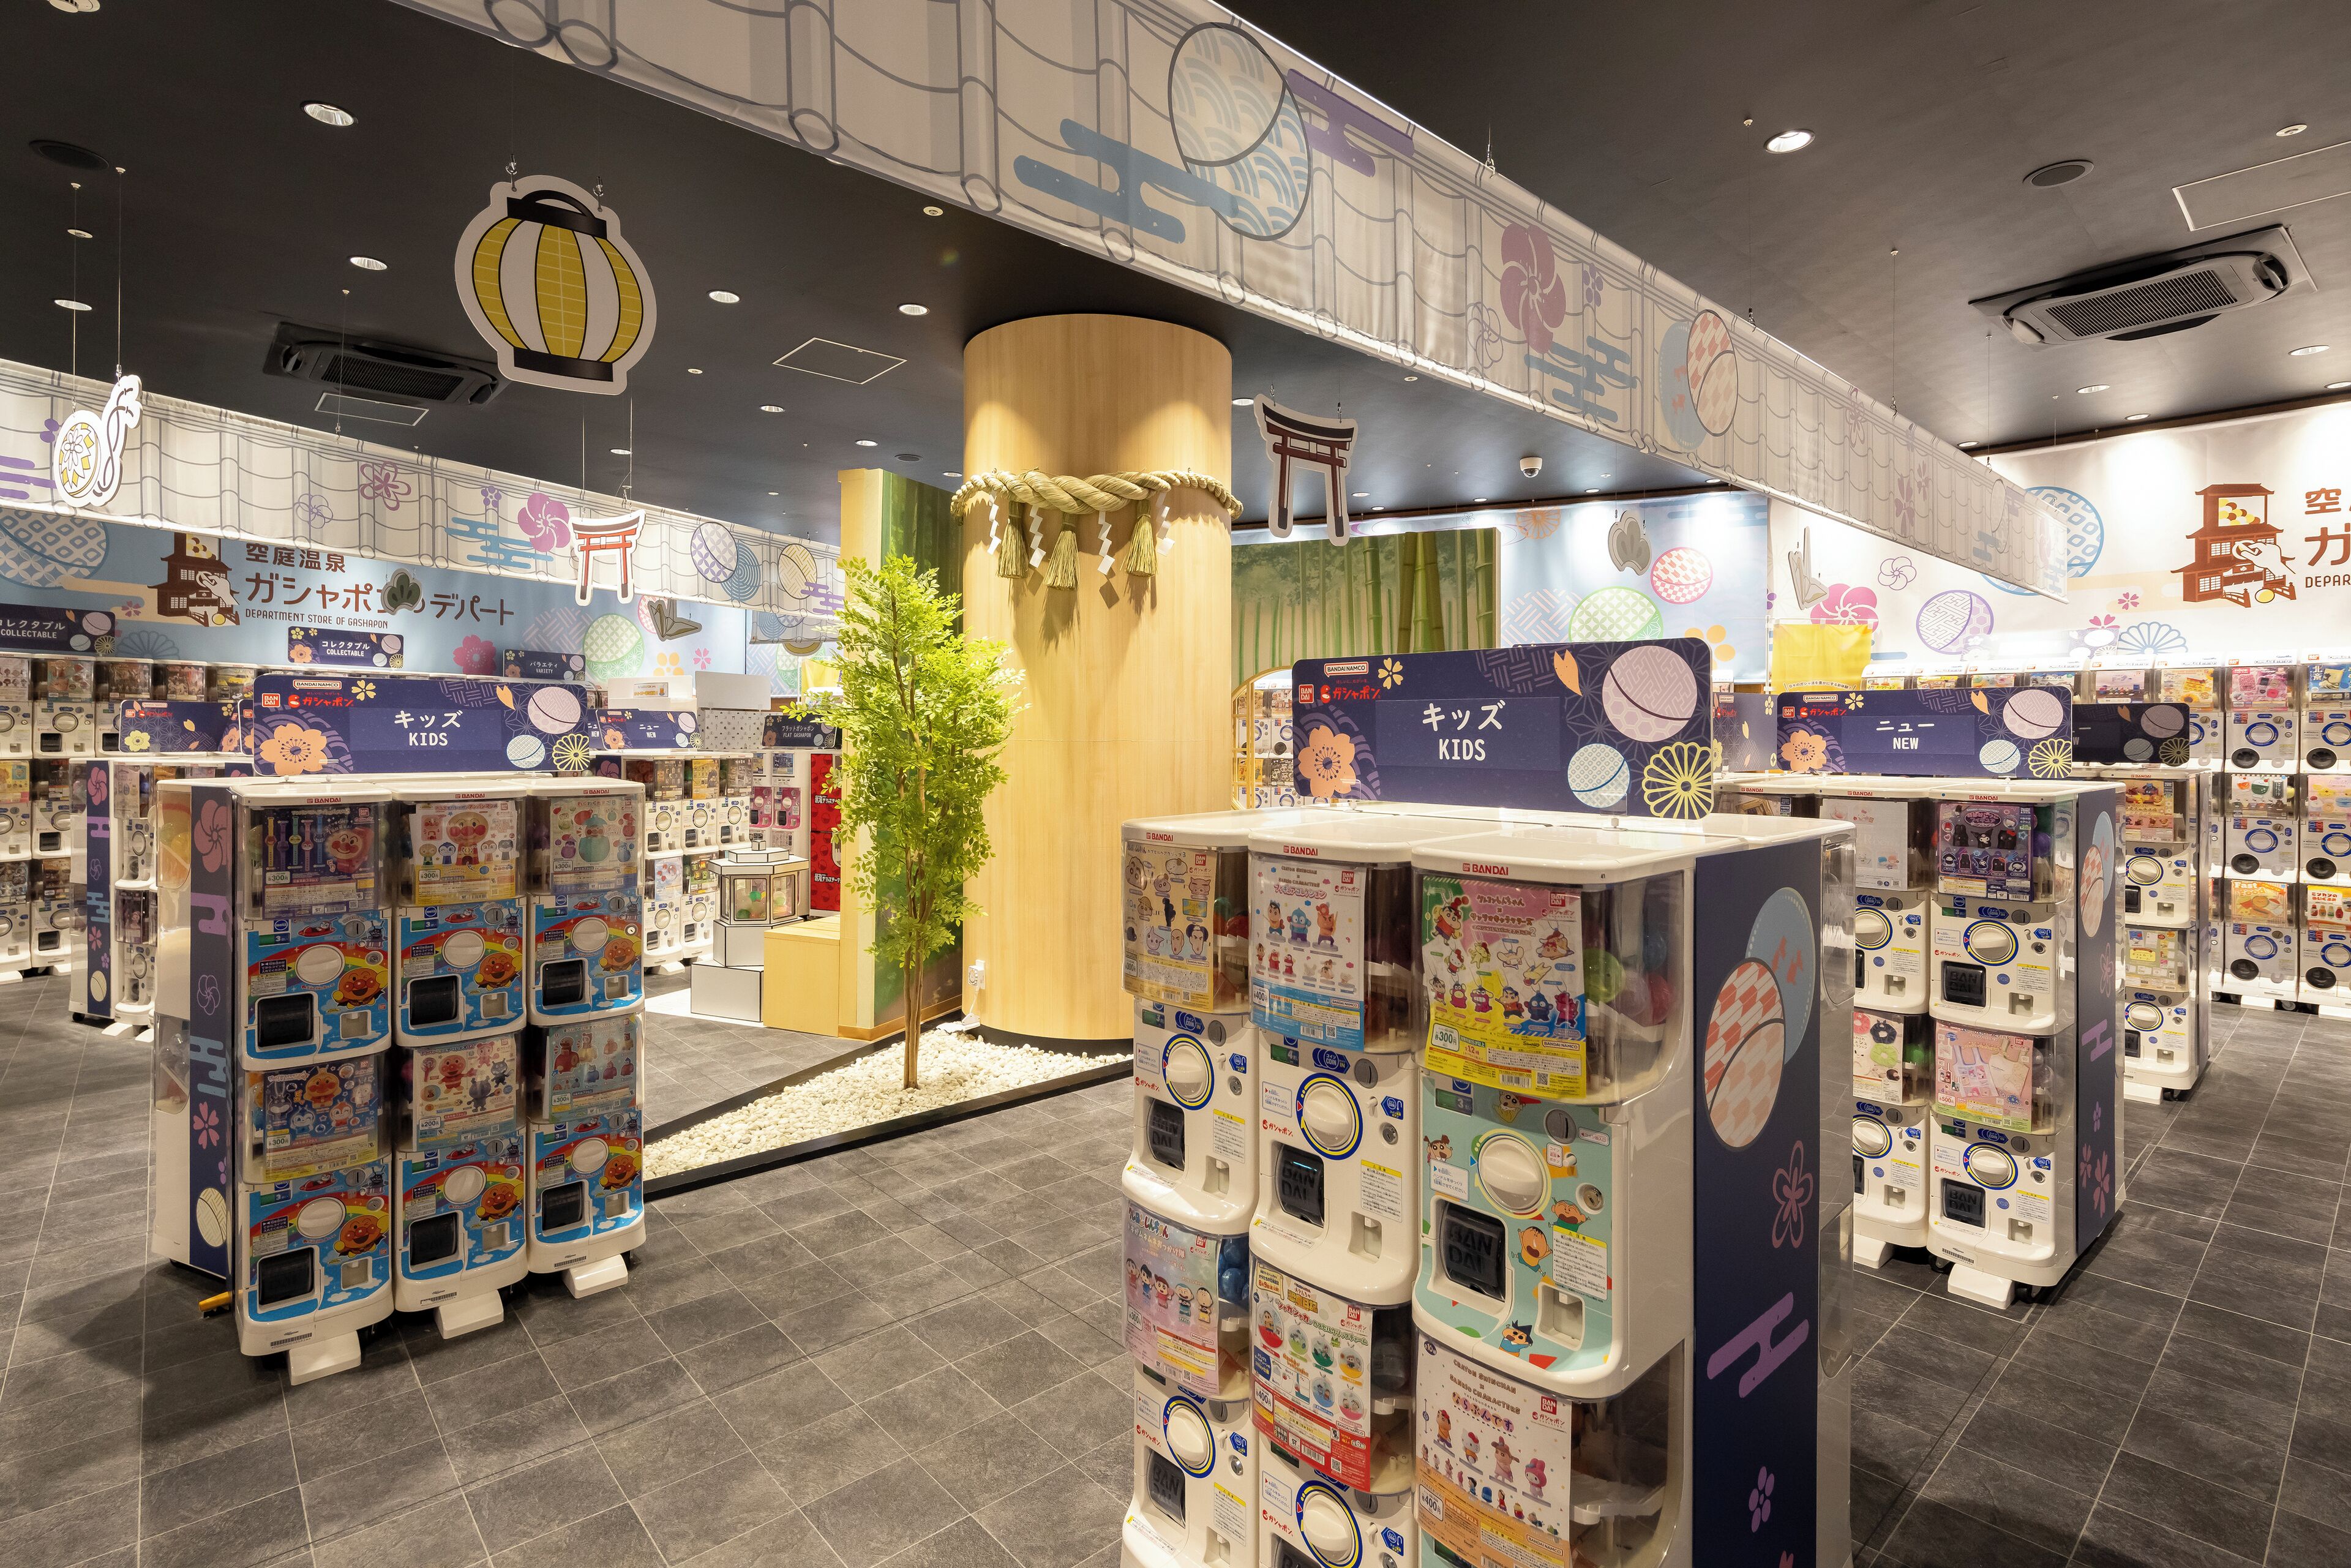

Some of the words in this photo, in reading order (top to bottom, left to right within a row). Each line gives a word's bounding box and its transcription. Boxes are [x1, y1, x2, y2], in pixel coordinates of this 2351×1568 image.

[2305, 488, 2351, 514] 空
[246, 543, 345, 573] 空庭温泉
[2305, 574, 2351, 588] DEPAR
[246, 572, 514, 626] ガシャポデパート
[246, 609, 304, 622] DEPARTMENT
[308, 615, 333, 624] STORE
[348, 618, 388, 629] GASHAPON
[1, 629, 57, 639] COLLECTABLE
[321, 640, 370, 650] コレクタブル
[326, 648, 364, 657] COLLECTABLE
[1333, 685, 1381, 700] ガシャポン
[302, 697, 353, 707] ガシャポン
[394, 710, 463, 728] キッズ
[1422, 700, 1505, 731] キッズ
[1876, 720, 1935, 732] ニュー
[409, 733, 448, 746] KIDS
[1893, 737, 1918, 749] NEW
[1439, 738, 1486, 761] KIDS
[1152, 833, 1173, 841] BANDAI
[1291, 847, 1318, 856] BANDAI
[1472, 864, 1509, 876] BANDAI
[1273, 884, 1327, 899] フィギュアコレクション
[1477, 894, 1525, 907] クレヨンしんちゃん
[1470, 913, 1534, 926] サンリオキャラクターズ
[1472, 925, 1536, 937] スペシャルラバーマスコット2
[1950, 972, 1977, 984] BAN
[1435, 1030, 1457, 1046] 各300円
[1140, 1078, 1160, 1092] ガシャポン
[1268, 1123, 1294, 1137] ガシャポン
[1282, 1168, 1314, 1188] BAN
[1433, 1174, 1462, 1186] ハンドルをゆっくり
[1282, 1180, 1307, 1200] DAI
[1949, 1190, 1976, 1205] BAN
[1949, 1200, 1970, 1212] DAI
[1128, 1206, 1169, 1240] クレヨンしんちゃん
[1449, 1229, 1491, 1256] BAN
[1449, 1246, 1482, 1274] DAI
[1346, 1321, 1367, 1330] ガシャポン
[1453, 1359, 1477, 1378] CRAYON
[1479, 1373, 1517, 1395] SHINCHAN
[1450, 1374, 1472, 1393] SANRIO
[1472, 1389, 1521, 1415] CHARACTERS
[1542, 1398, 1556, 1408] BAN
[1542, 1404, 1553, 1412] DAI
[1452, 1391, 1513, 1433] ならぶんです。
[1337, 1422, 1350, 1431] BANDAI
[1539, 1414, 1565, 1426] ガシャポン
[1141, 1430, 1161, 1447] ガシャポン
[1422, 1495, 1441, 1516] 各400円
[1268, 1515, 1294, 1536] ガシャポン
[1528, 1537, 1545, 1549] BANDAI
[1545, 1543, 1562, 1555] NAMCO
